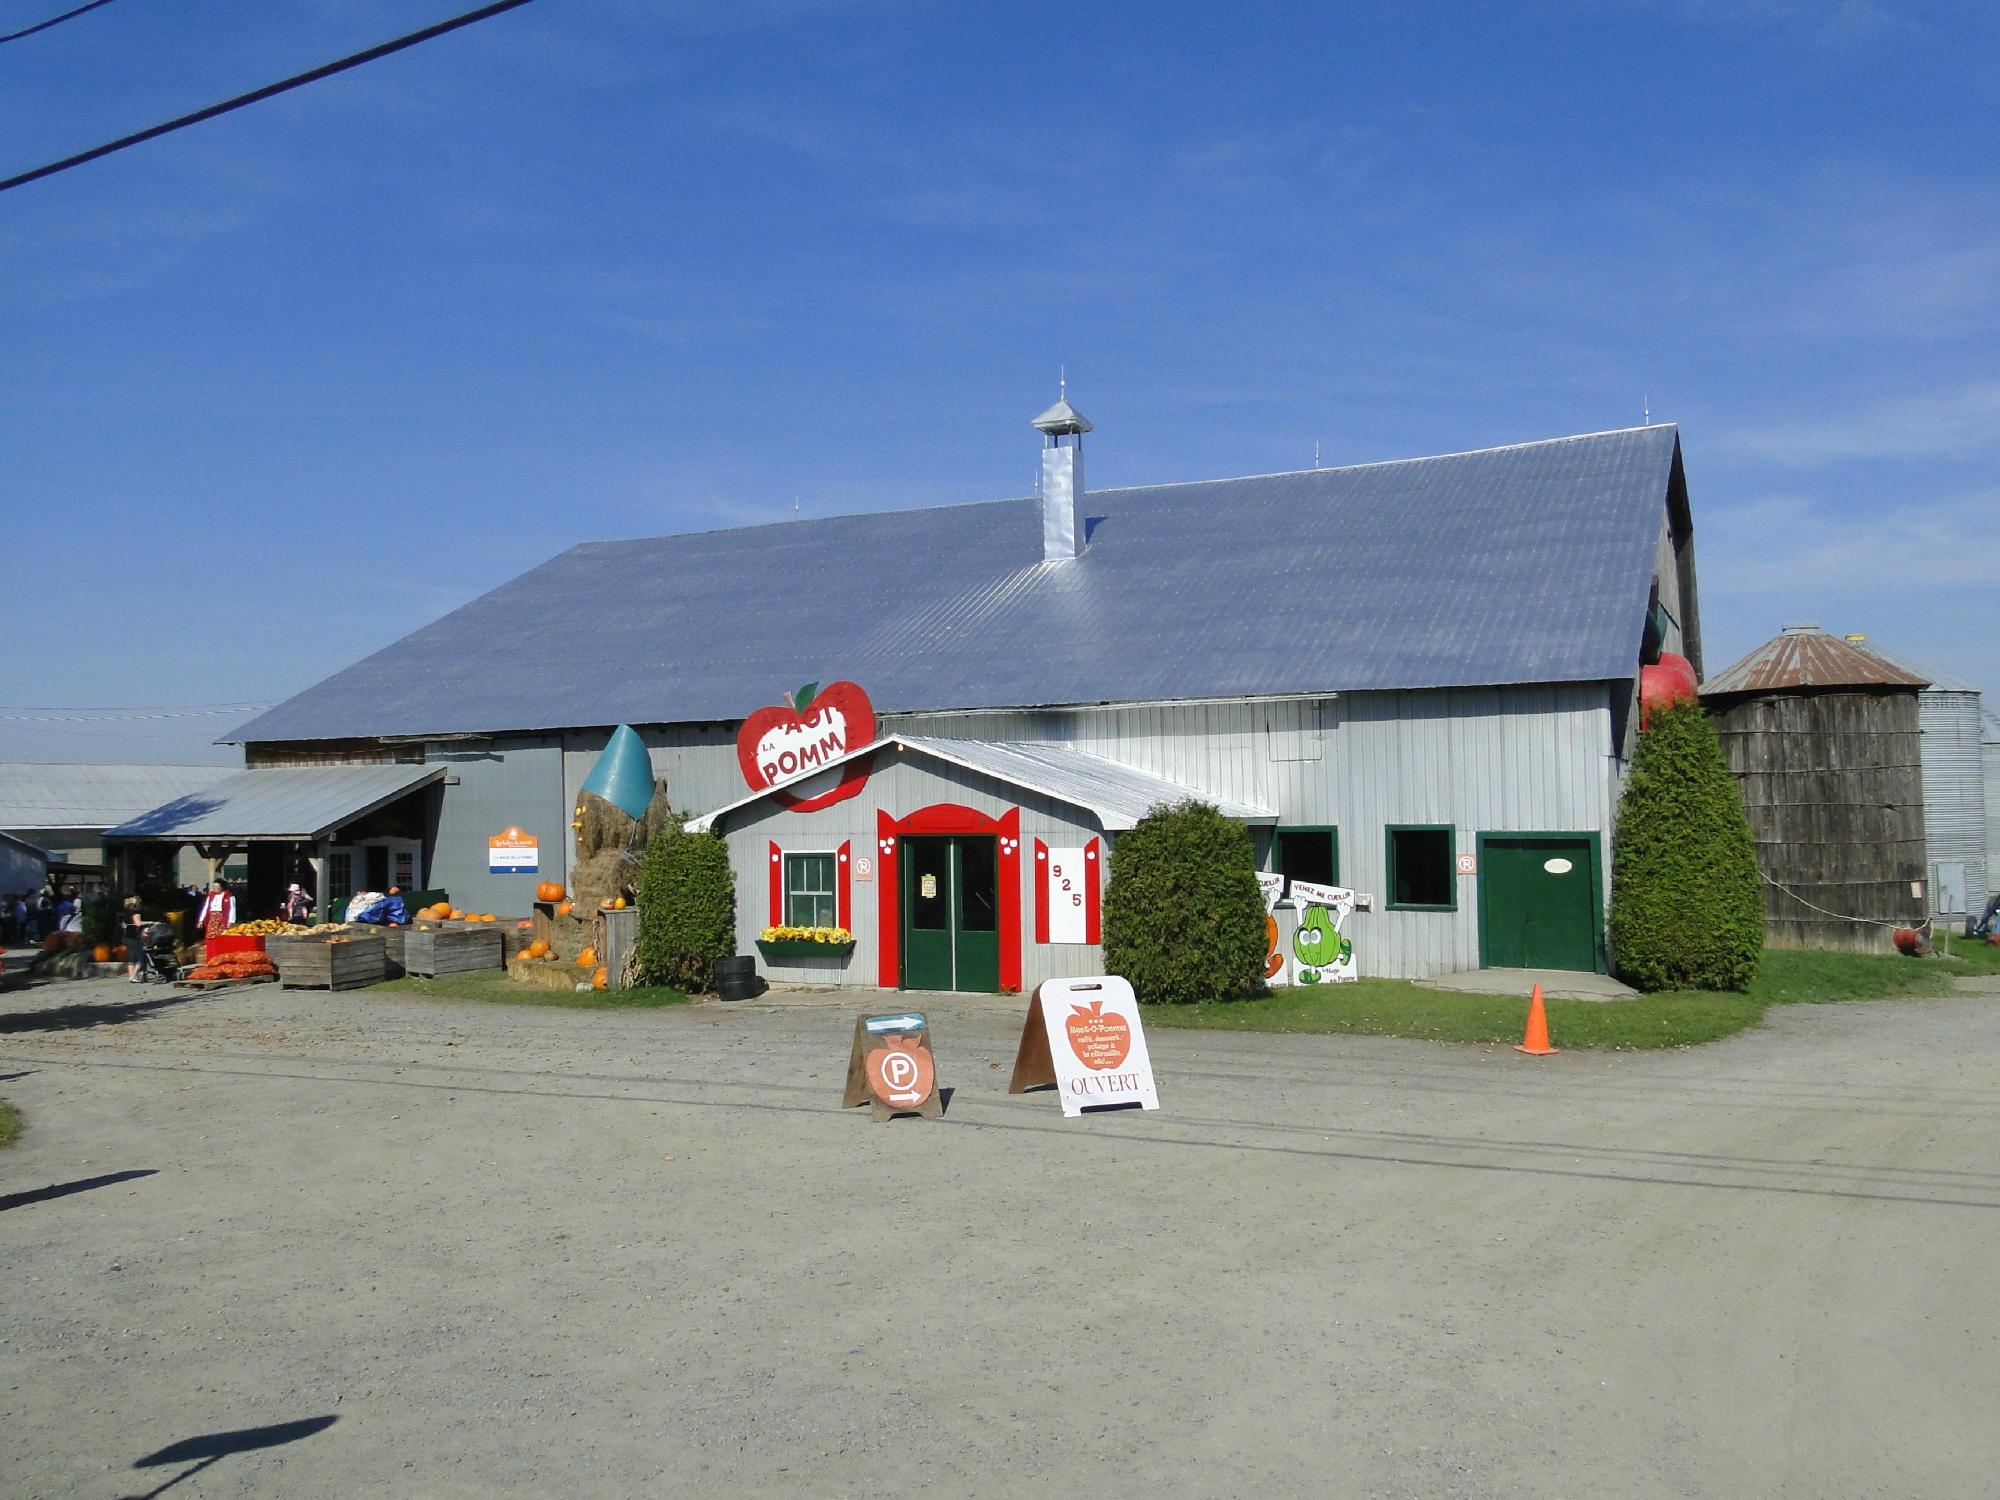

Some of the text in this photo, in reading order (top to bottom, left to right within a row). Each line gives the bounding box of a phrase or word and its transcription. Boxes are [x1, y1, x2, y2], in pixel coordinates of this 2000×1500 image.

[762, 742, 776, 752] LA
[763, 731, 846, 786] POMM
[1294, 884, 1315, 894] VENEZ
[1327, 891, 1351, 901] CUEILLIR
[891, 1060, 909, 1084] P
[1071, 1073, 1139, 1095] OUVERT
